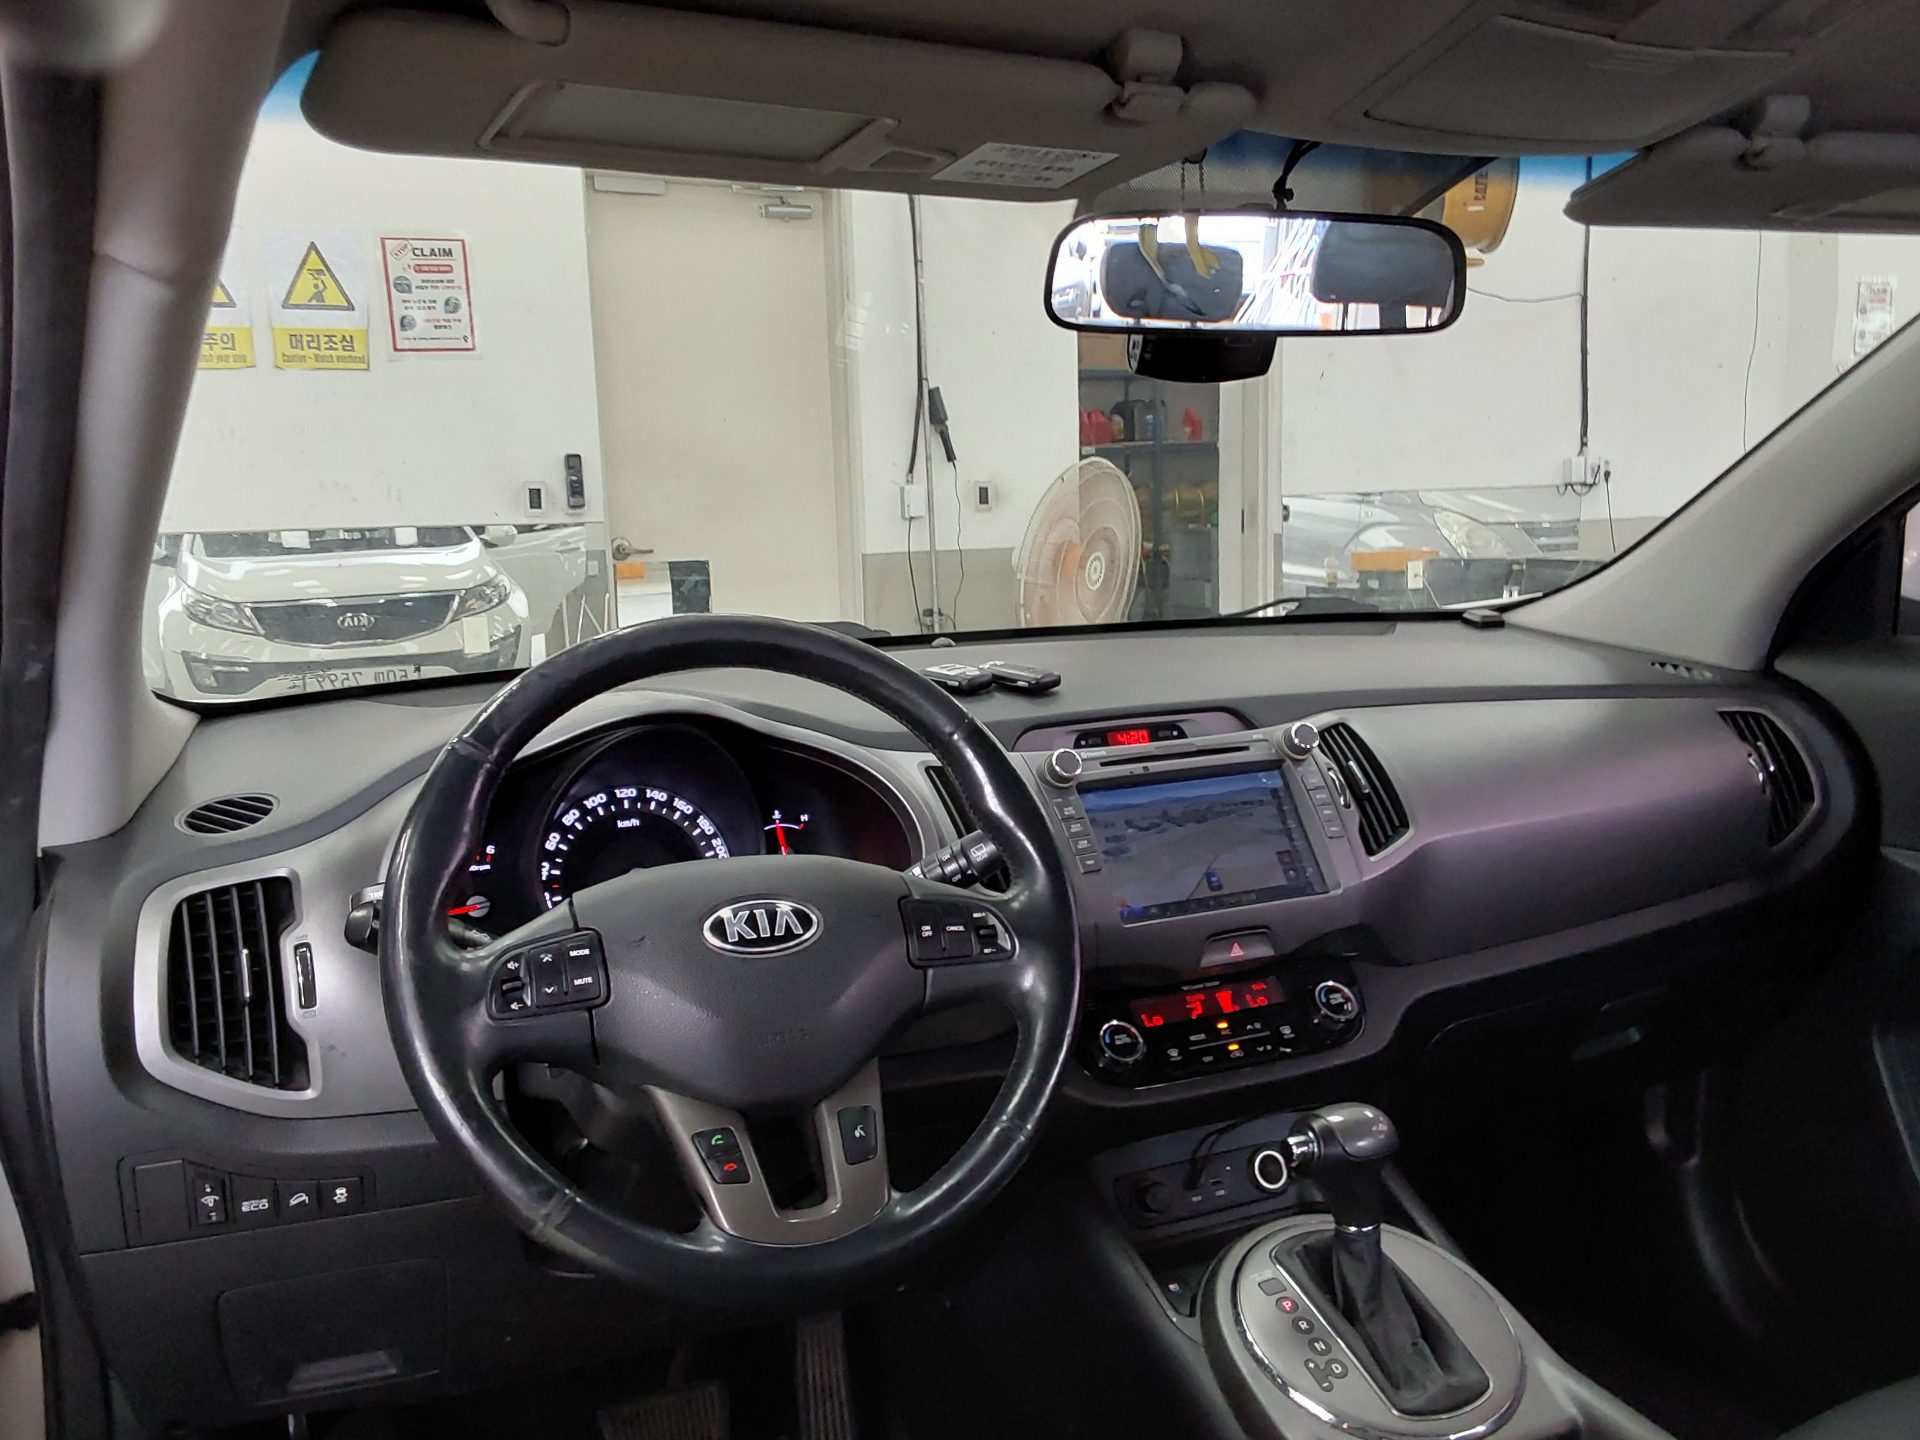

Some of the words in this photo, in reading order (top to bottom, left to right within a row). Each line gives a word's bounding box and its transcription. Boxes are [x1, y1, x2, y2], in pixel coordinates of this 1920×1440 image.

[412, 247, 453, 258] CLAIM
[288, 333, 355, 353] 머리조심
[1116, 729, 1149, 746] 4:20
[614, 788, 637, 798] 120
[645, 789, 667, 802] 140
[583, 793, 607, 809] 100
[672, 797, 693, 815] 160
[561, 809, 580, 826] 80
[617, 819, 640, 828] km/h
[696, 815, 715, 836] 180
[544, 832, 560, 851] 60
[485, 845, 496, 855] 6
[720, 908, 803, 943] KIA
[569, 948, 590, 957] MODE
[573, 977, 593, 986] MUTE
[241, 1202, 269, 1213] ECO
[1281, 1300, 1292, 1312] P
[1298, 1320, 1309, 1331] R
[1314, 1340, 1326, 1352] N
[1331, 1363, 1342, 1374] D
